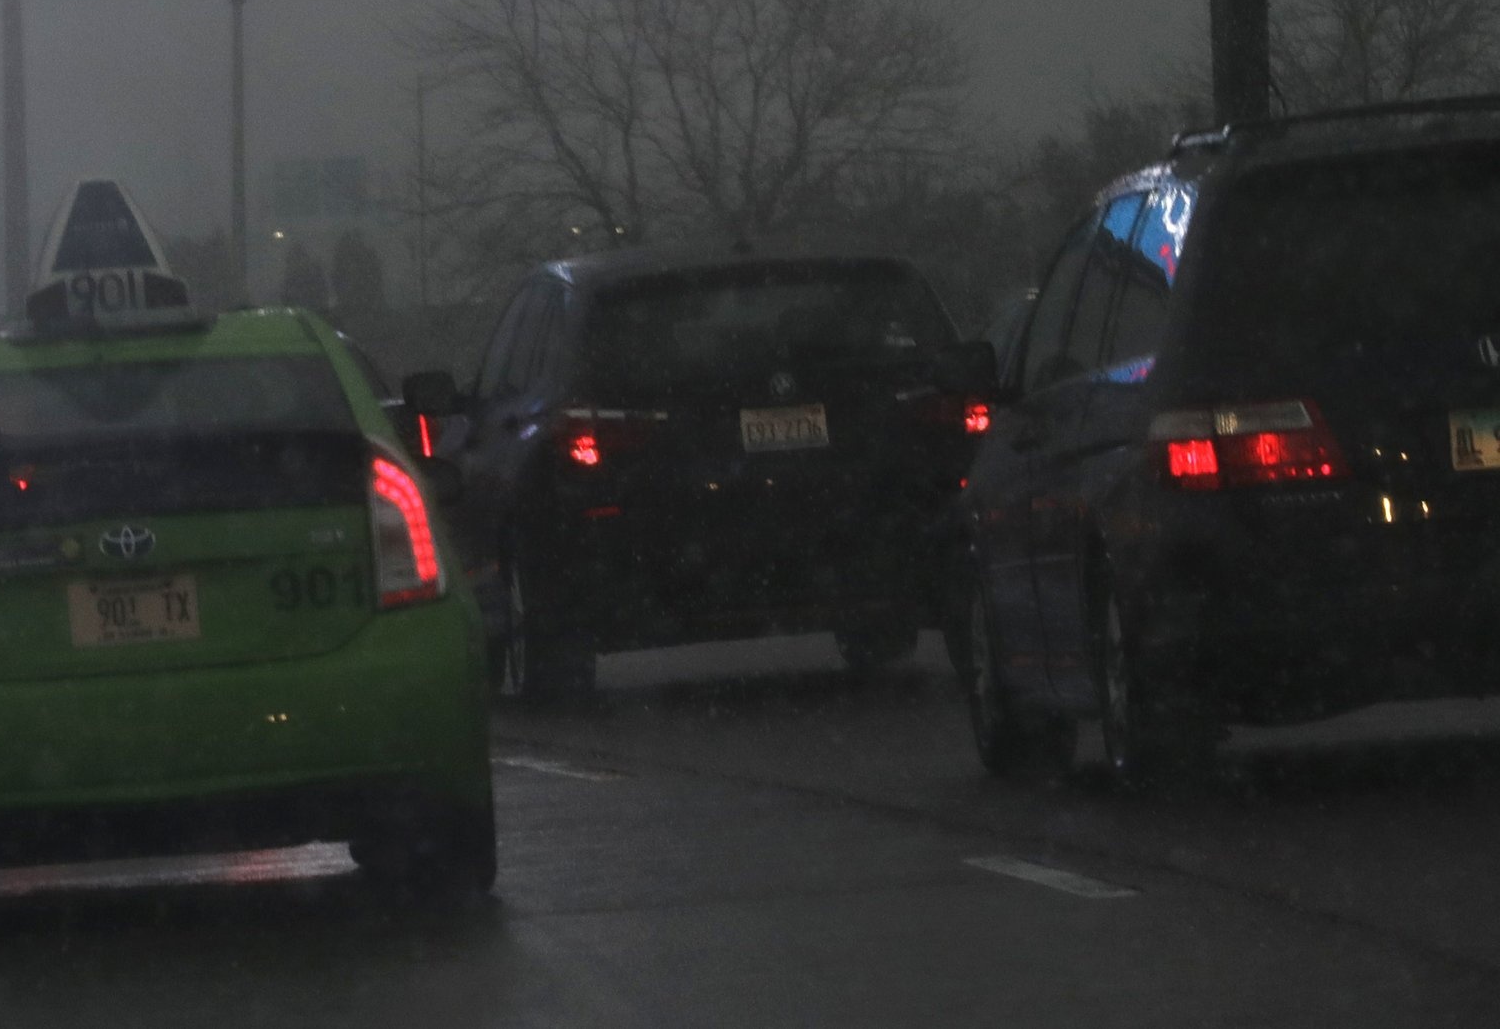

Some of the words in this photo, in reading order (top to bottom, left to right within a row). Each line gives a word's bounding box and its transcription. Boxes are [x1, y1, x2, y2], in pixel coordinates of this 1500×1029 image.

[70, 268, 137, 316] 901
[163, 590, 191, 622] TX
[270, 566, 365, 610] 901
